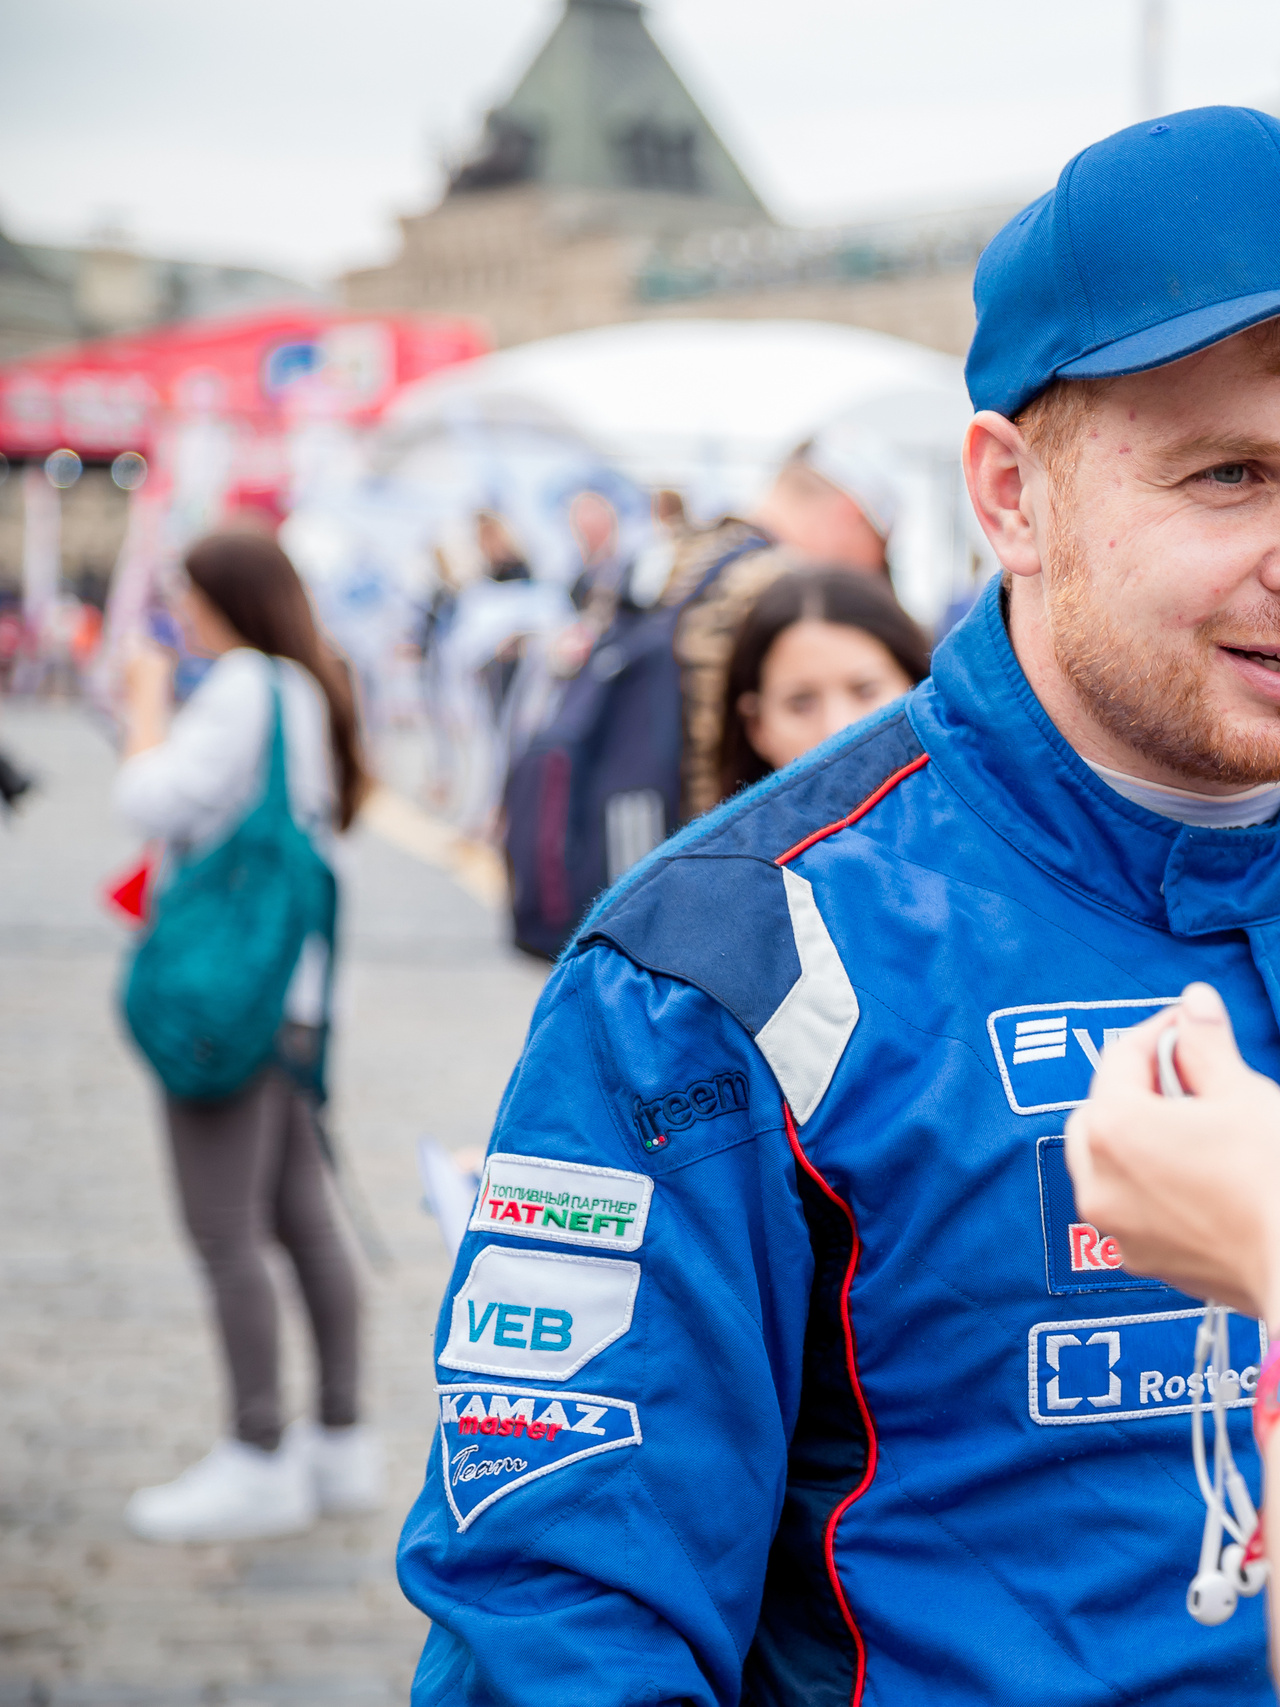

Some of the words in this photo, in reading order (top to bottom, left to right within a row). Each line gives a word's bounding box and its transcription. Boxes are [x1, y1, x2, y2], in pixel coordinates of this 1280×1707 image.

[634, 1073, 749, 1143] freem
[488, 1199, 635, 1237] TATNEFT
[492, 1184, 570, 1207] ТОПЛИВНЫЙ
[571, 1196, 638, 1215] ПАРТНЕР
[1069, 1223, 1124, 1271] Re
[468, 1299, 573, 1352] VEB
[442, 1393, 608, 1436] KAMAZ
[458, 1414, 563, 1442] master
[451, 1444, 528, 1487] Team
